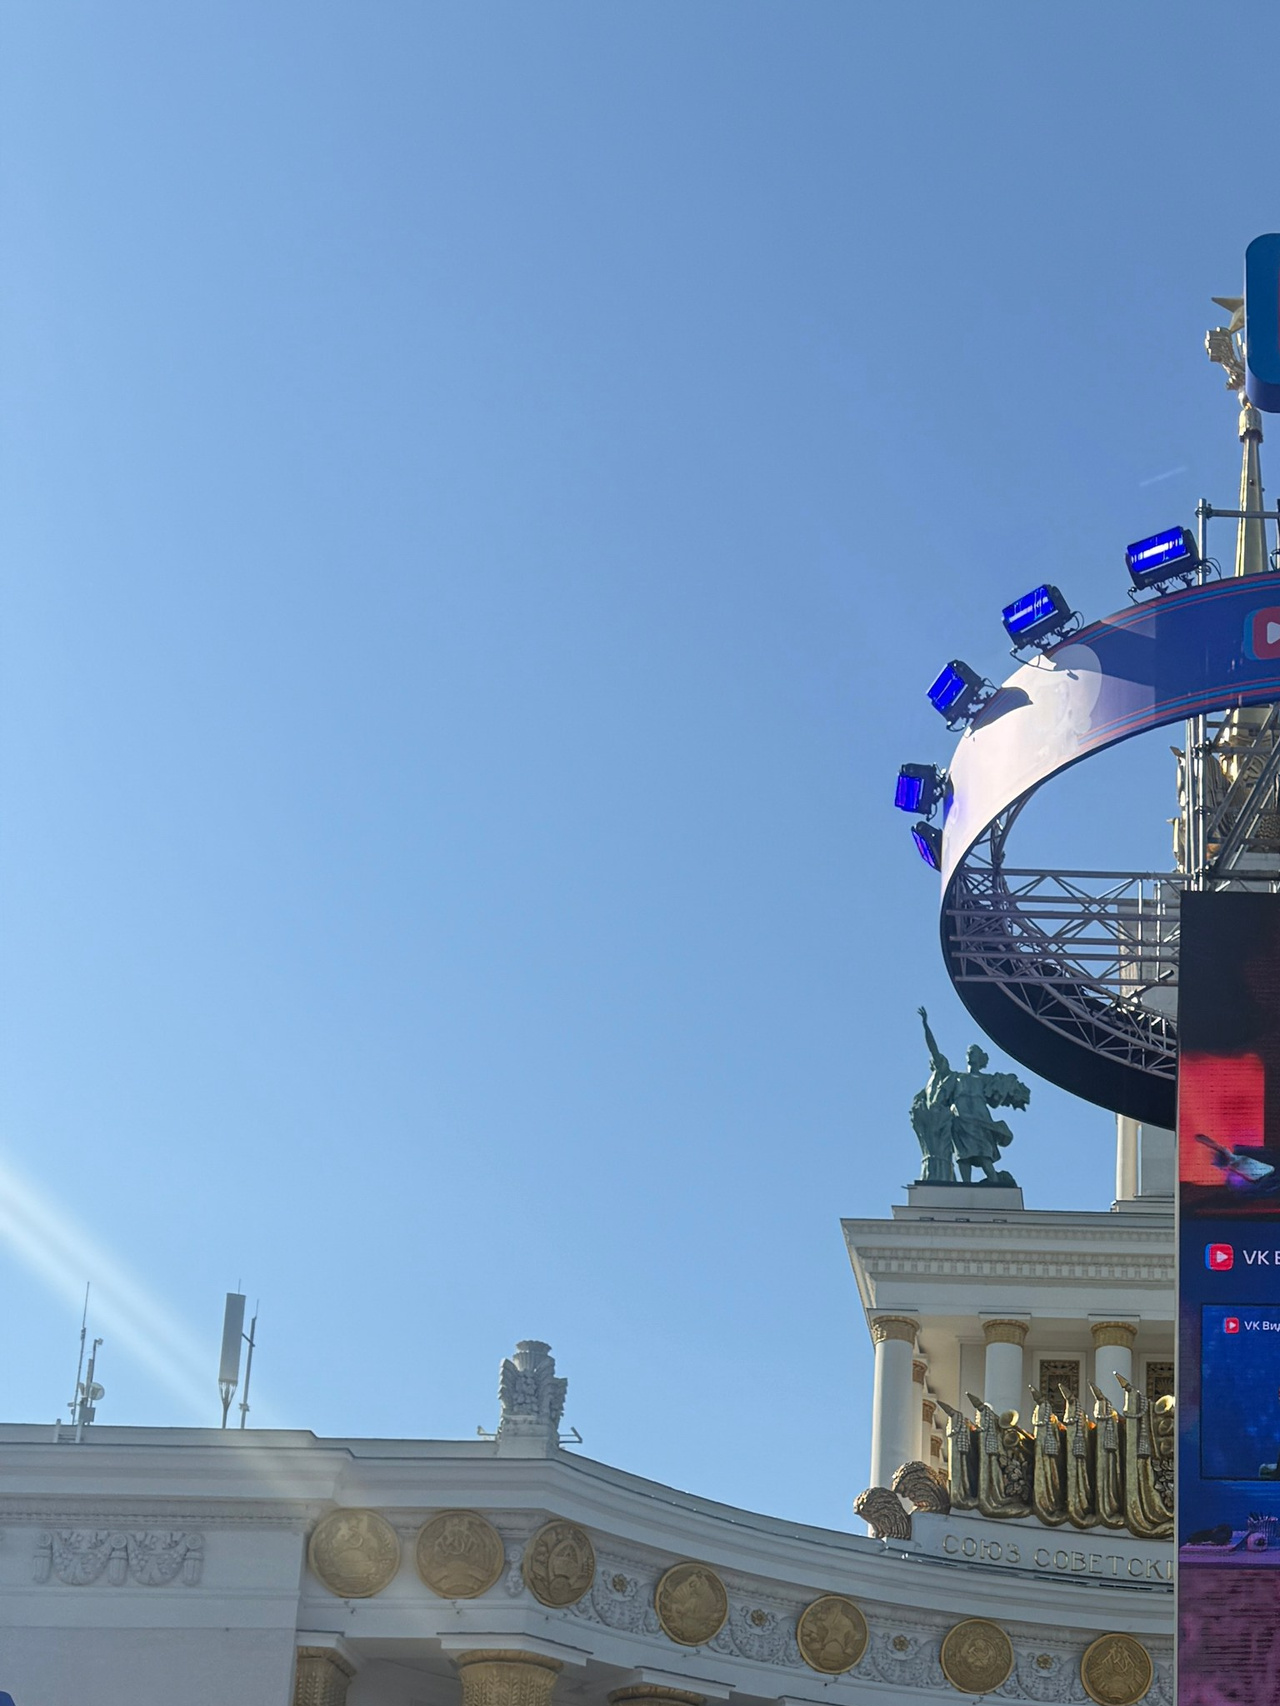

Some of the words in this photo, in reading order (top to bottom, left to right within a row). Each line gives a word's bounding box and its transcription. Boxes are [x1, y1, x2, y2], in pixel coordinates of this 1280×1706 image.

[1243, 1250, 1270, 1265] VK
[1244, 1321, 1261, 1331] VK
[942, 1534, 1021, 1563] СОЮЗ
